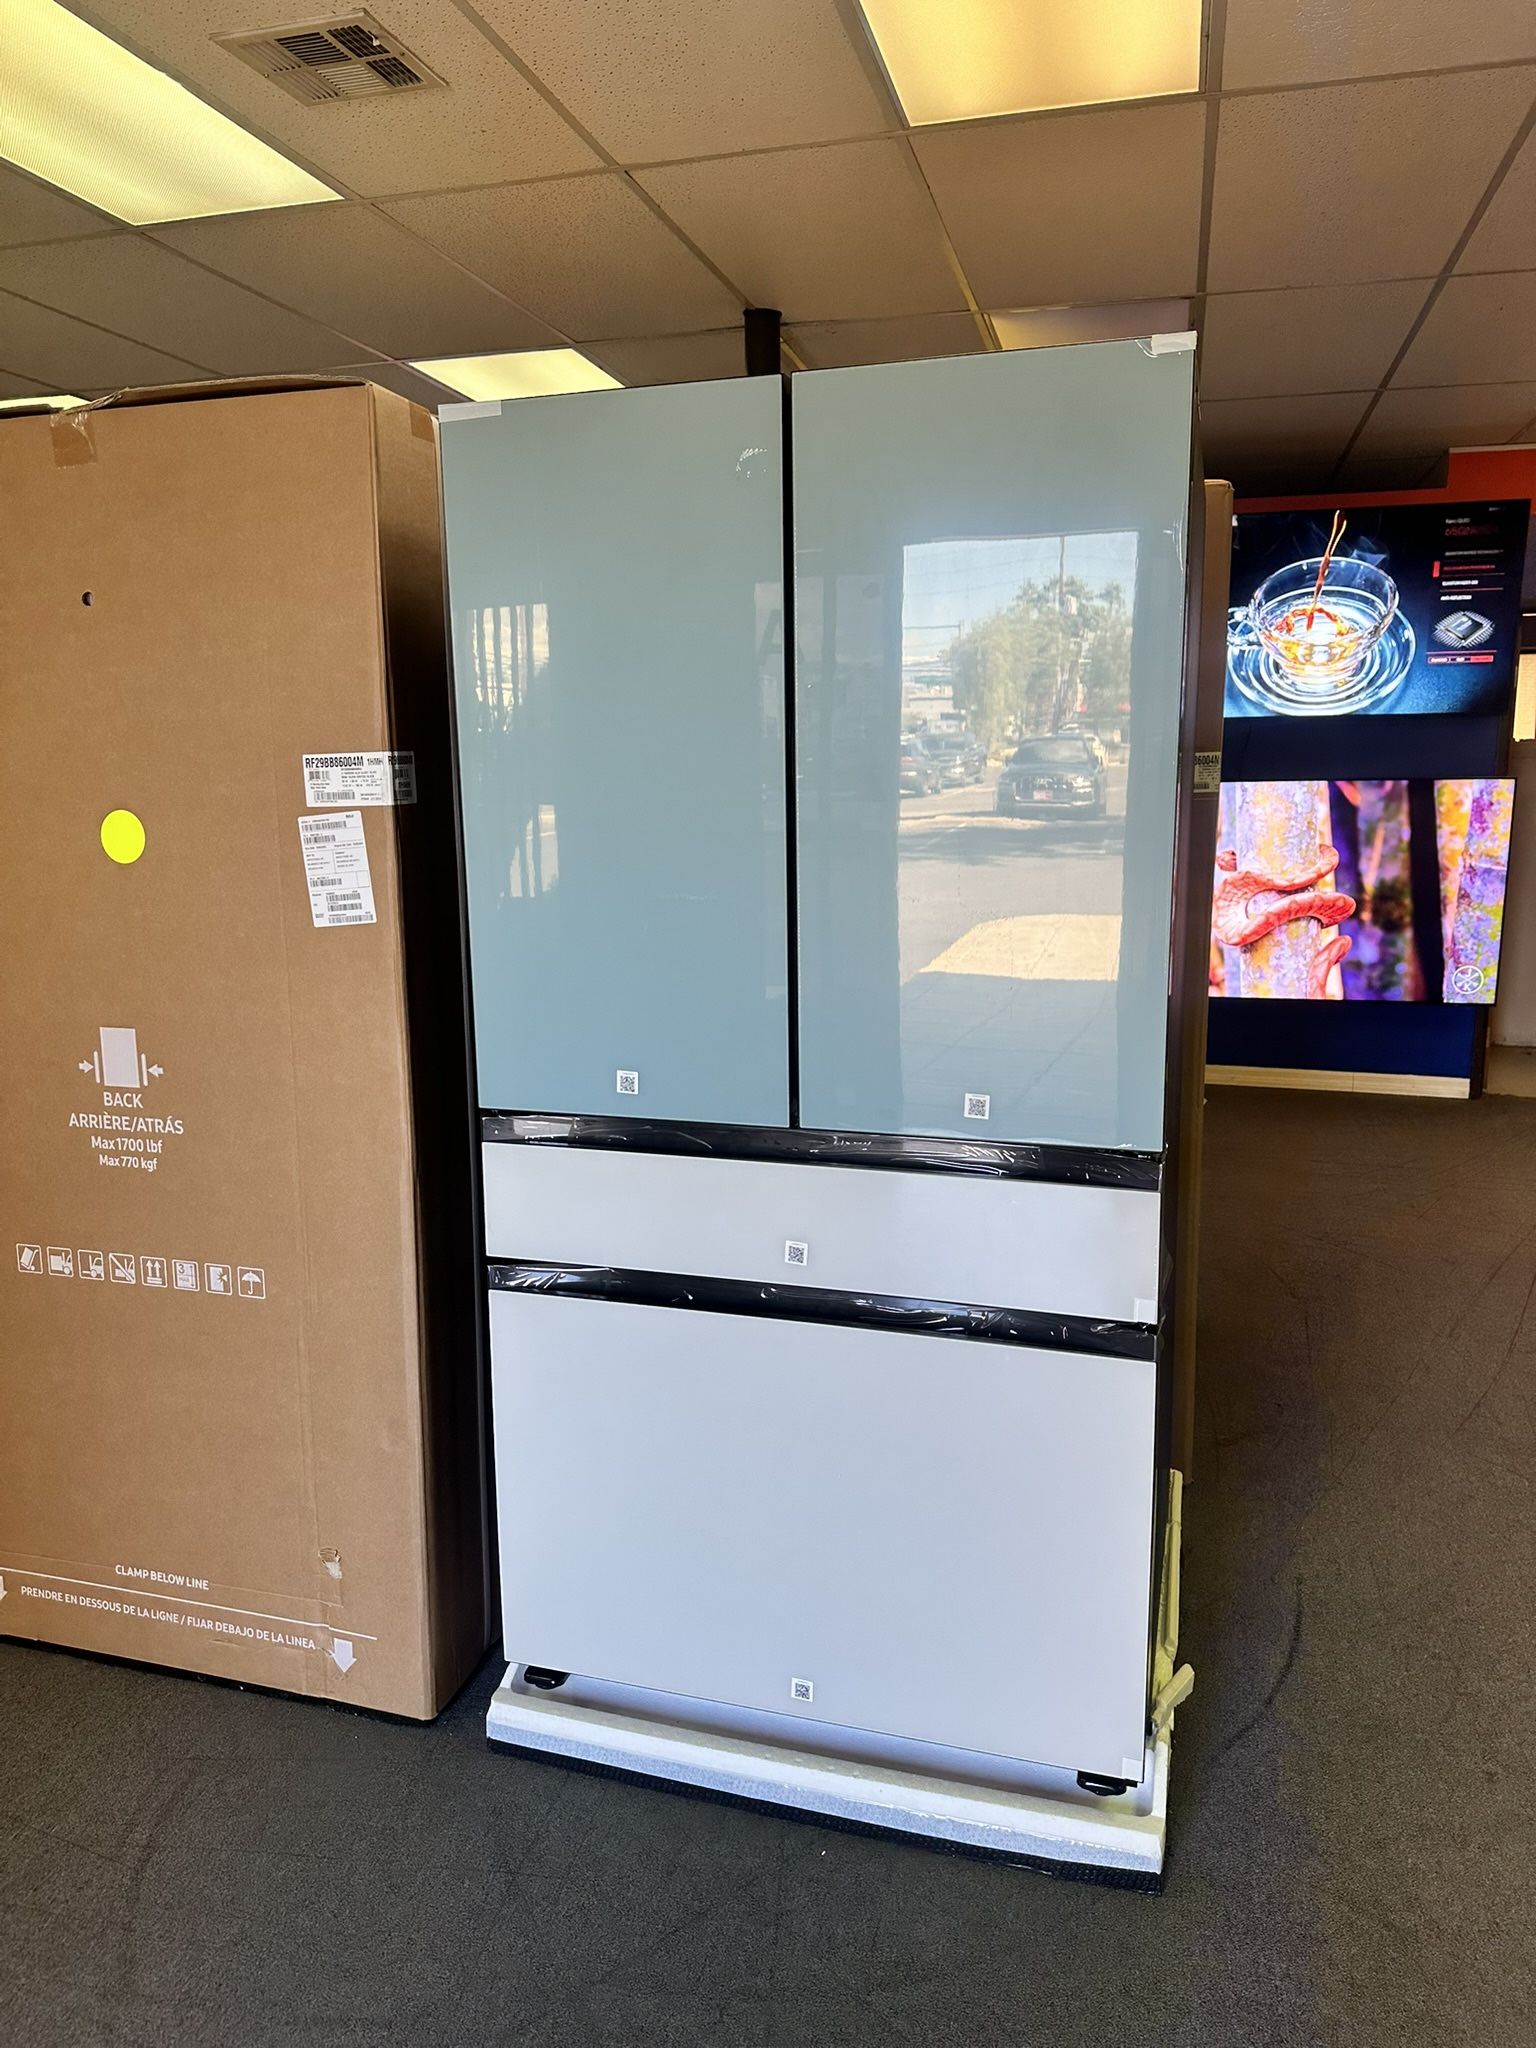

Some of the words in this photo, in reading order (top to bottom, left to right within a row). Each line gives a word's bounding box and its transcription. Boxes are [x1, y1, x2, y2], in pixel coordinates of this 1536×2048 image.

[103, 1091, 144, 1109] BACK
[69, 1111, 184, 1135] ARRIÈRE/ATRÁS
[91, 1135, 116, 1150] Max
[116, 1136, 144, 1152] 1700
[146, 1138, 163, 1154] lbf
[99, 1154, 120, 1167] Max
[121, 1155, 139, 1169] 770
[141, 1157, 158, 1173] kgf
[115, 1564, 149, 1579] CLAMP
[150, 1570, 185, 1586] BELOW
[186, 1577, 209, 1590] LINE
[20, 1585, 63, 1602] PRENDRE
[65, 1593, 78, 1604] EN
[79, 1596, 122, 1613] DESSOUS
[123, 1604, 136, 1615] DE
[137, 1606, 150, 1618] LA
[151, 1609, 179, 1623] LIGNE
[180, 1615, 185, 1625] /
[187, 1616, 213, 1630] FIJAR
[215, 1621, 254, 1637] DEBAJO
[256, 1629, 270, 1641] DE
[271, 1632, 285, 1644] LA
[285, 1635, 316, 1650] LINEA
